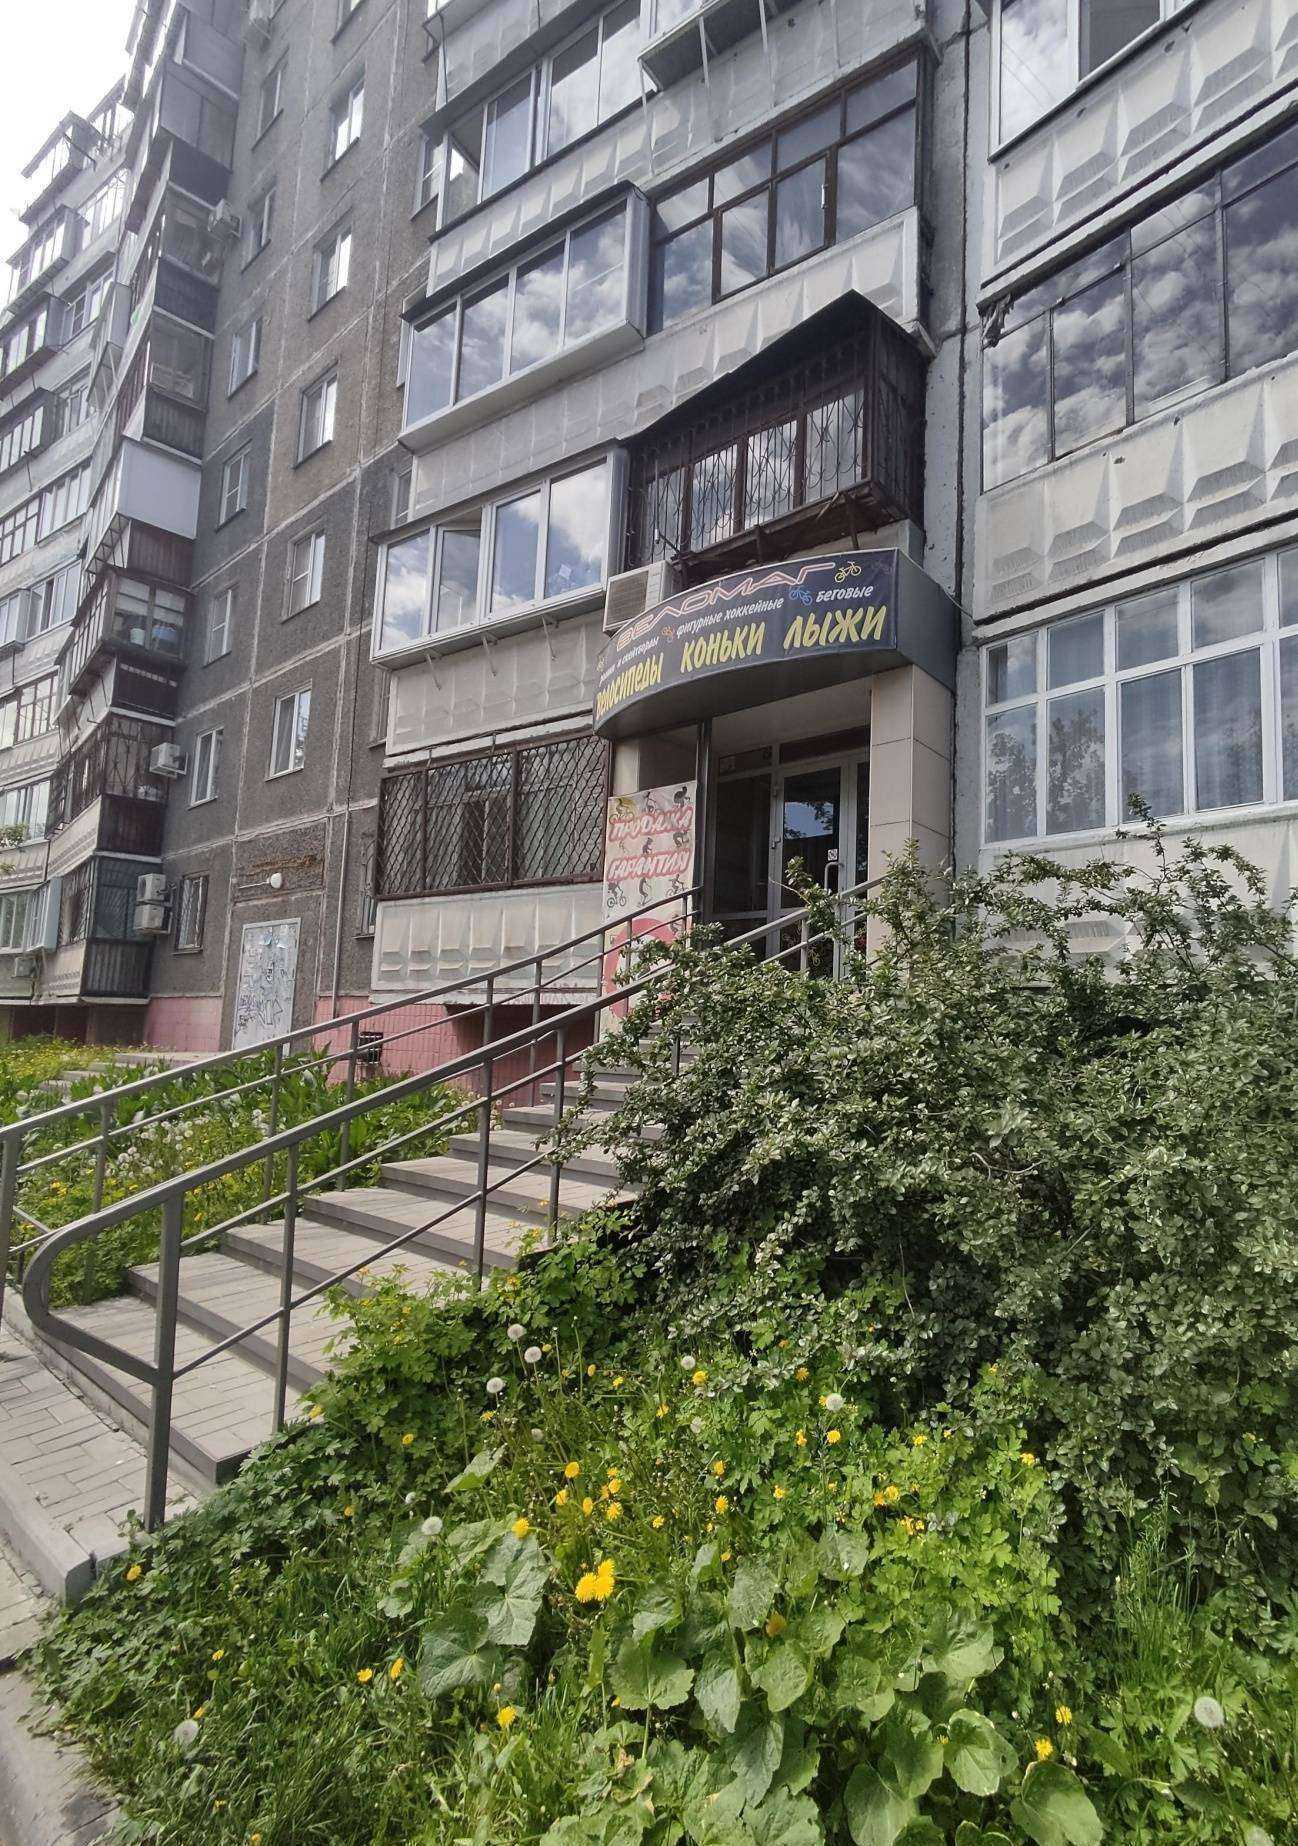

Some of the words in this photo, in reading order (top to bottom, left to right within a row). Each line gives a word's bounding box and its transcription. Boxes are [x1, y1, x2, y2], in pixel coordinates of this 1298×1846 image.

[617, 562, 836, 652] ВЕЛОМАГ
[677, 611, 723, 639] фигурные
[724, 597, 785, 620] хоккейные
[608, 849, 691, 884] ГАРАНТИЯ
